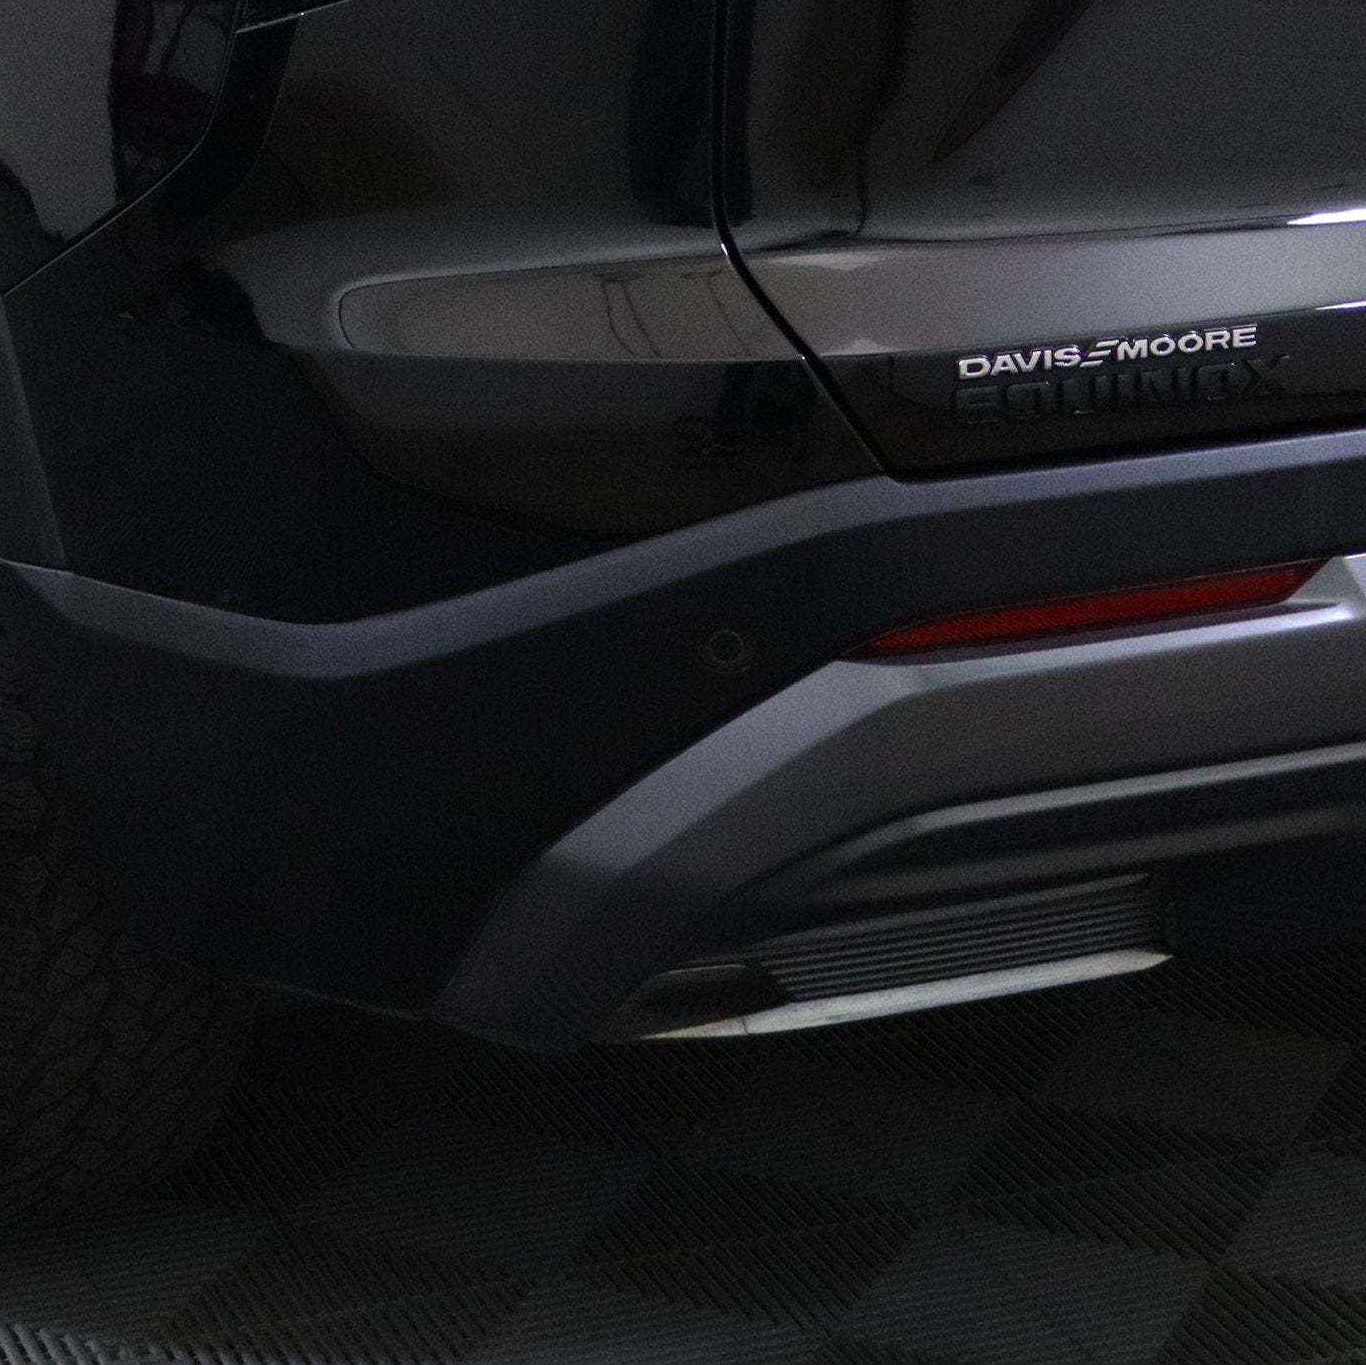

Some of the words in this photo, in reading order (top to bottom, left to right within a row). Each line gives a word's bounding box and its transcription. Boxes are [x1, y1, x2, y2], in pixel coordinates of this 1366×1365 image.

[958, 345, 1082, 380] DAVIS
[1116, 324, 1258, 362] MOORE
[954, 354, 1291, 426] EQUINOX
